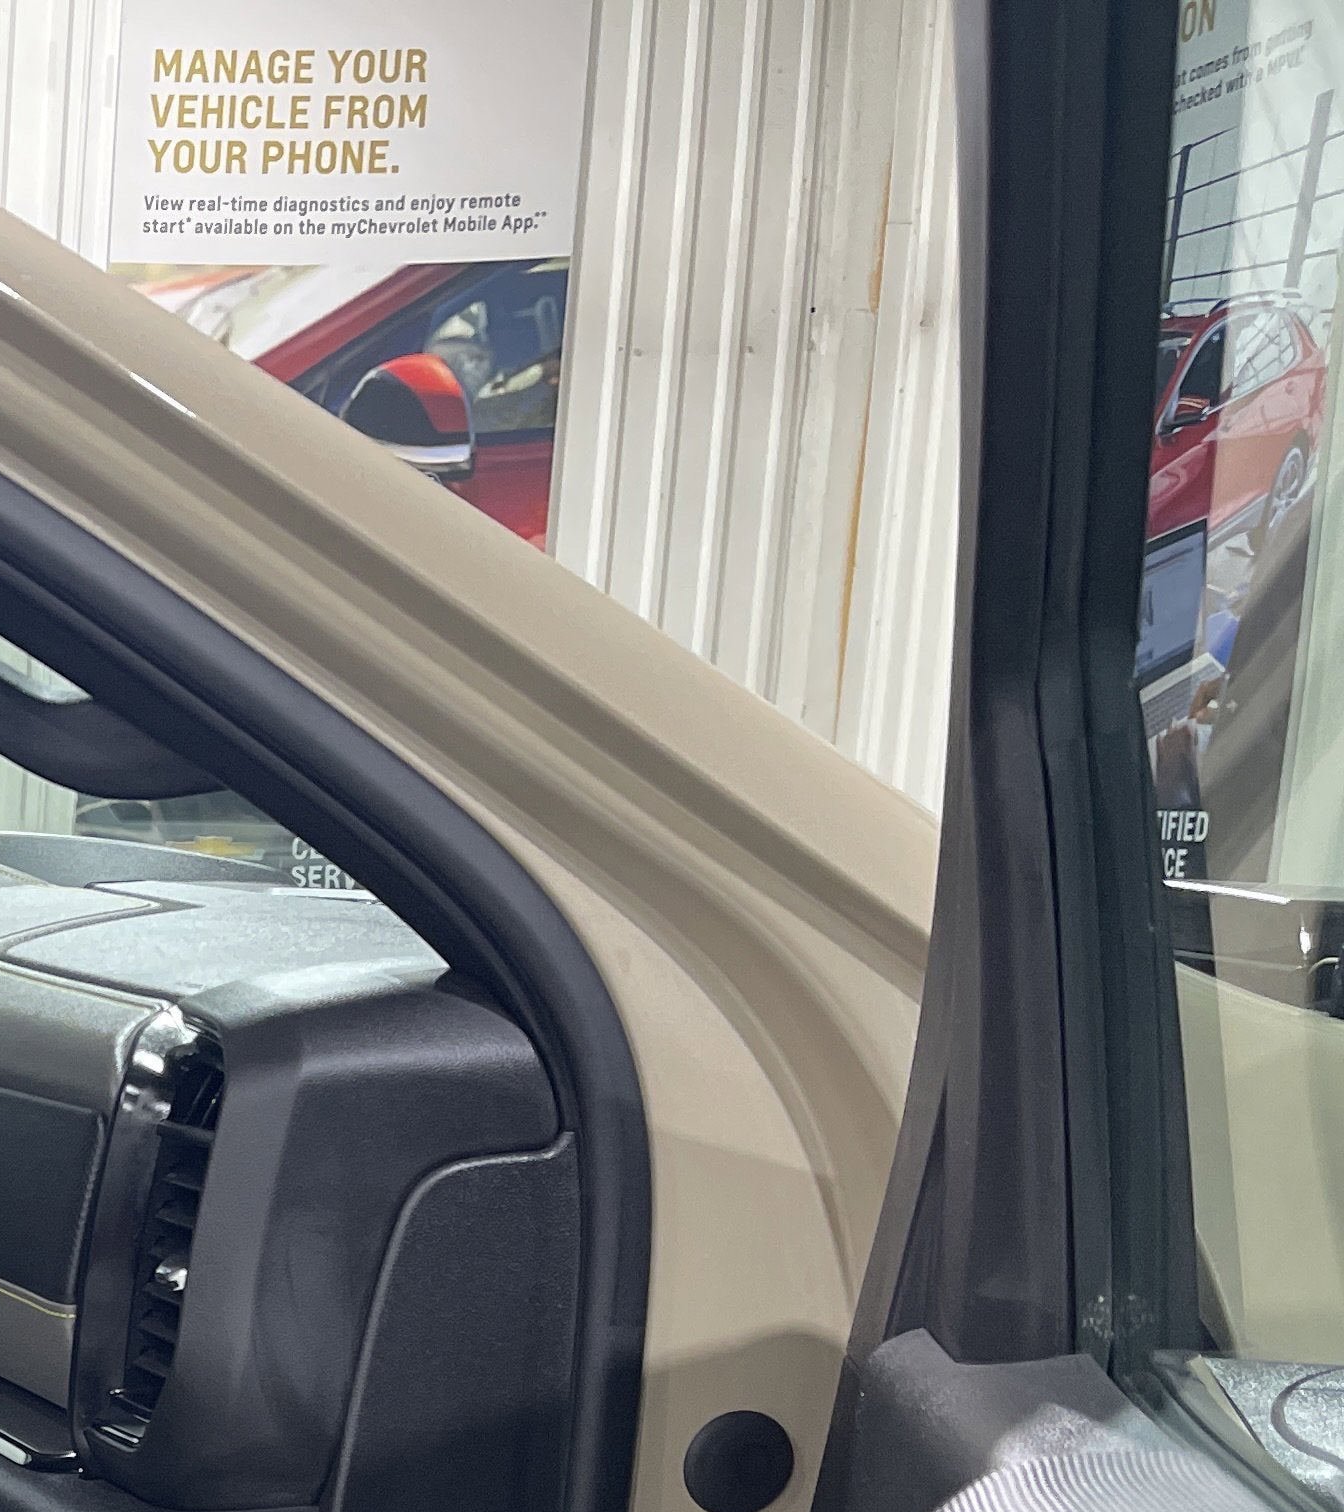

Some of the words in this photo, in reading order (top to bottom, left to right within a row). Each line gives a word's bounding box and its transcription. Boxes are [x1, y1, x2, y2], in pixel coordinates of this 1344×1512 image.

[153, 48, 316, 84] MANAGE
[327, 48, 429, 84] YOUR
[1189, 55, 1230, 83] comes
[150, 94, 311, 130] VEHICLE
[322, 94, 428, 129] FROM
[147, 139, 248, 175] YOUR
[261, 139, 401, 175] PHONE.
[143, 195, 184, 213] View
[188, 195, 268, 213] real-time
[272, 195, 370, 216] diagnostics
[374, 194, 406, 213] and
[410, 194, 455, 215] enjoy
[460, 192, 522, 210] remote
[193, 216, 268, 236] available
[272, 220, 294, 236] on
[298, 218, 327, 236] the
[330, 217, 440, 239] myChevrolet
[443, 215, 497, 235] Mobile
